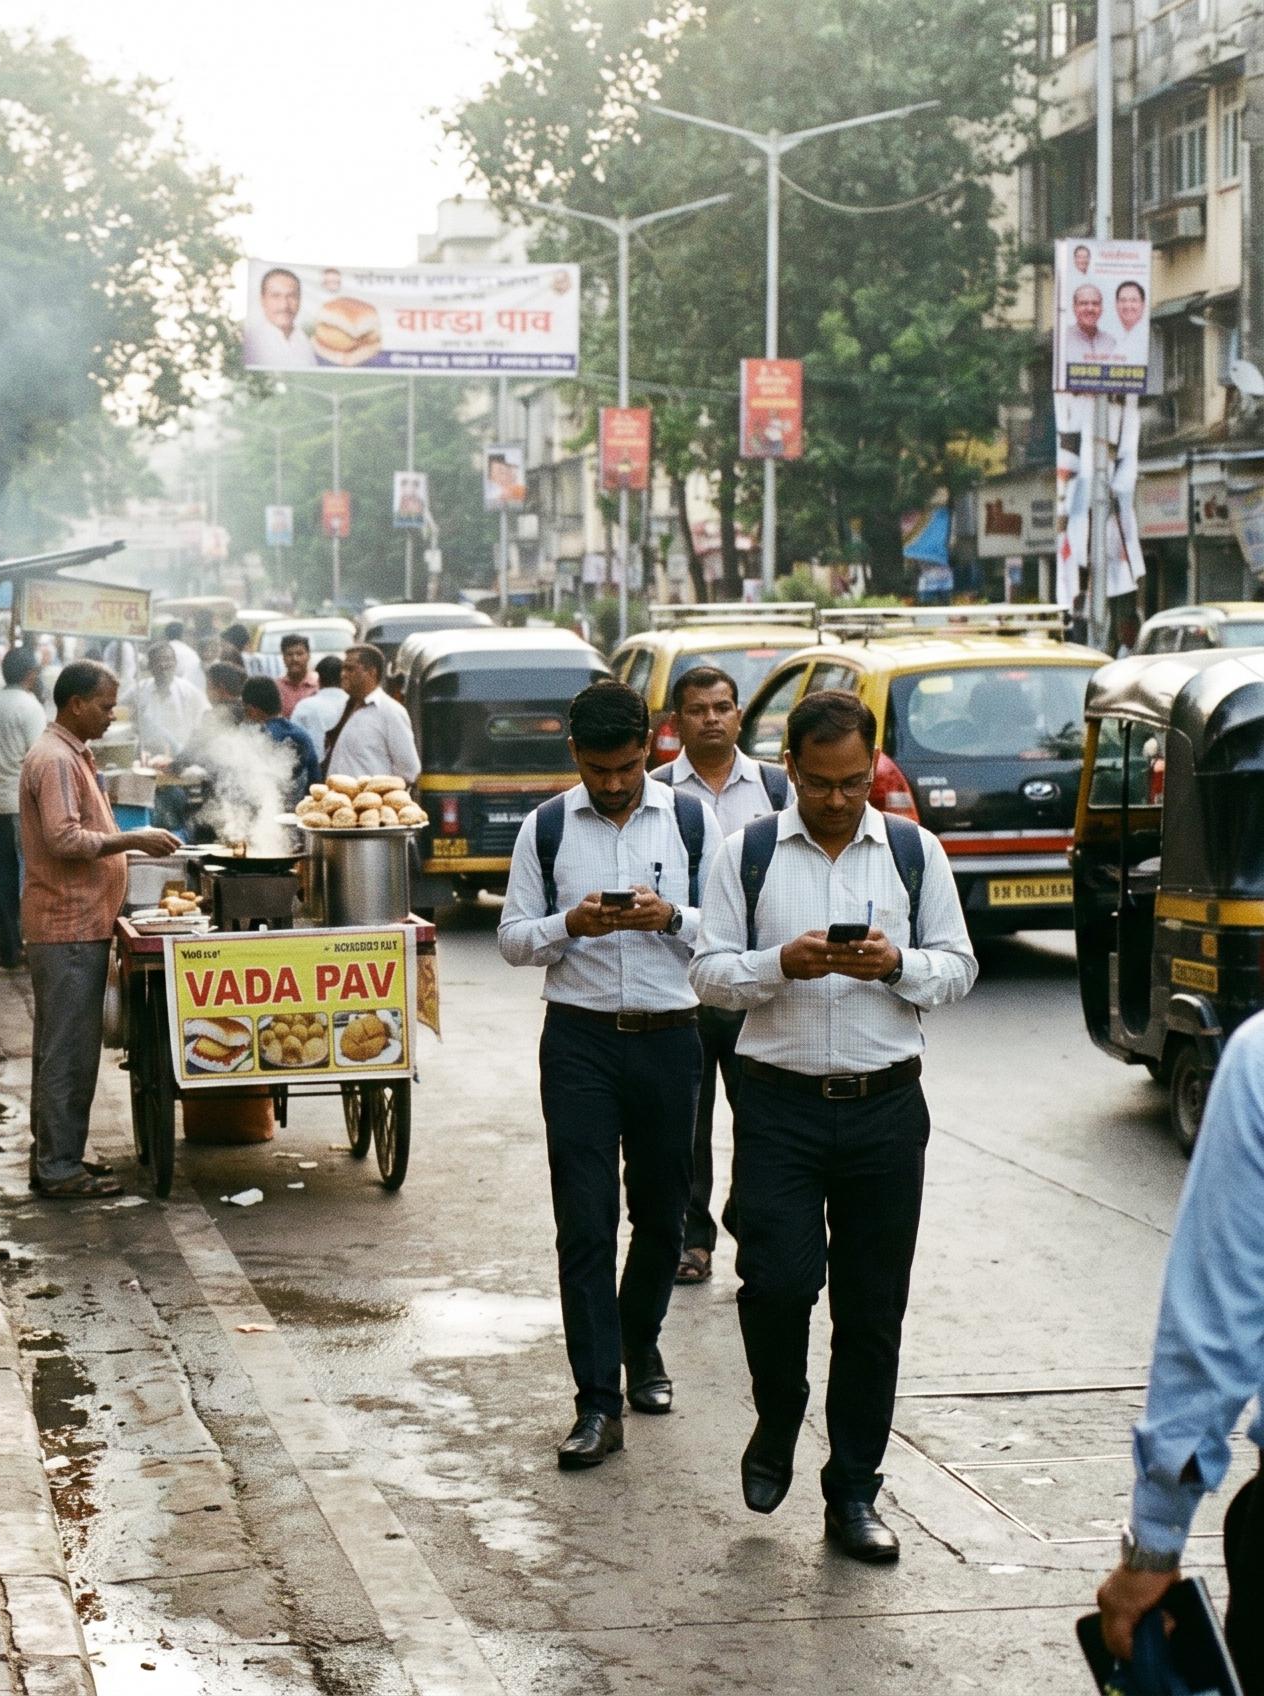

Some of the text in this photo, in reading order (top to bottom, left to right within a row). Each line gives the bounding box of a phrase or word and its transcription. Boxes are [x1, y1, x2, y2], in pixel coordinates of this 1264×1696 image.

[496, 308, 553, 333] पाव
[184, 961, 397, 1008] VADA PAV
